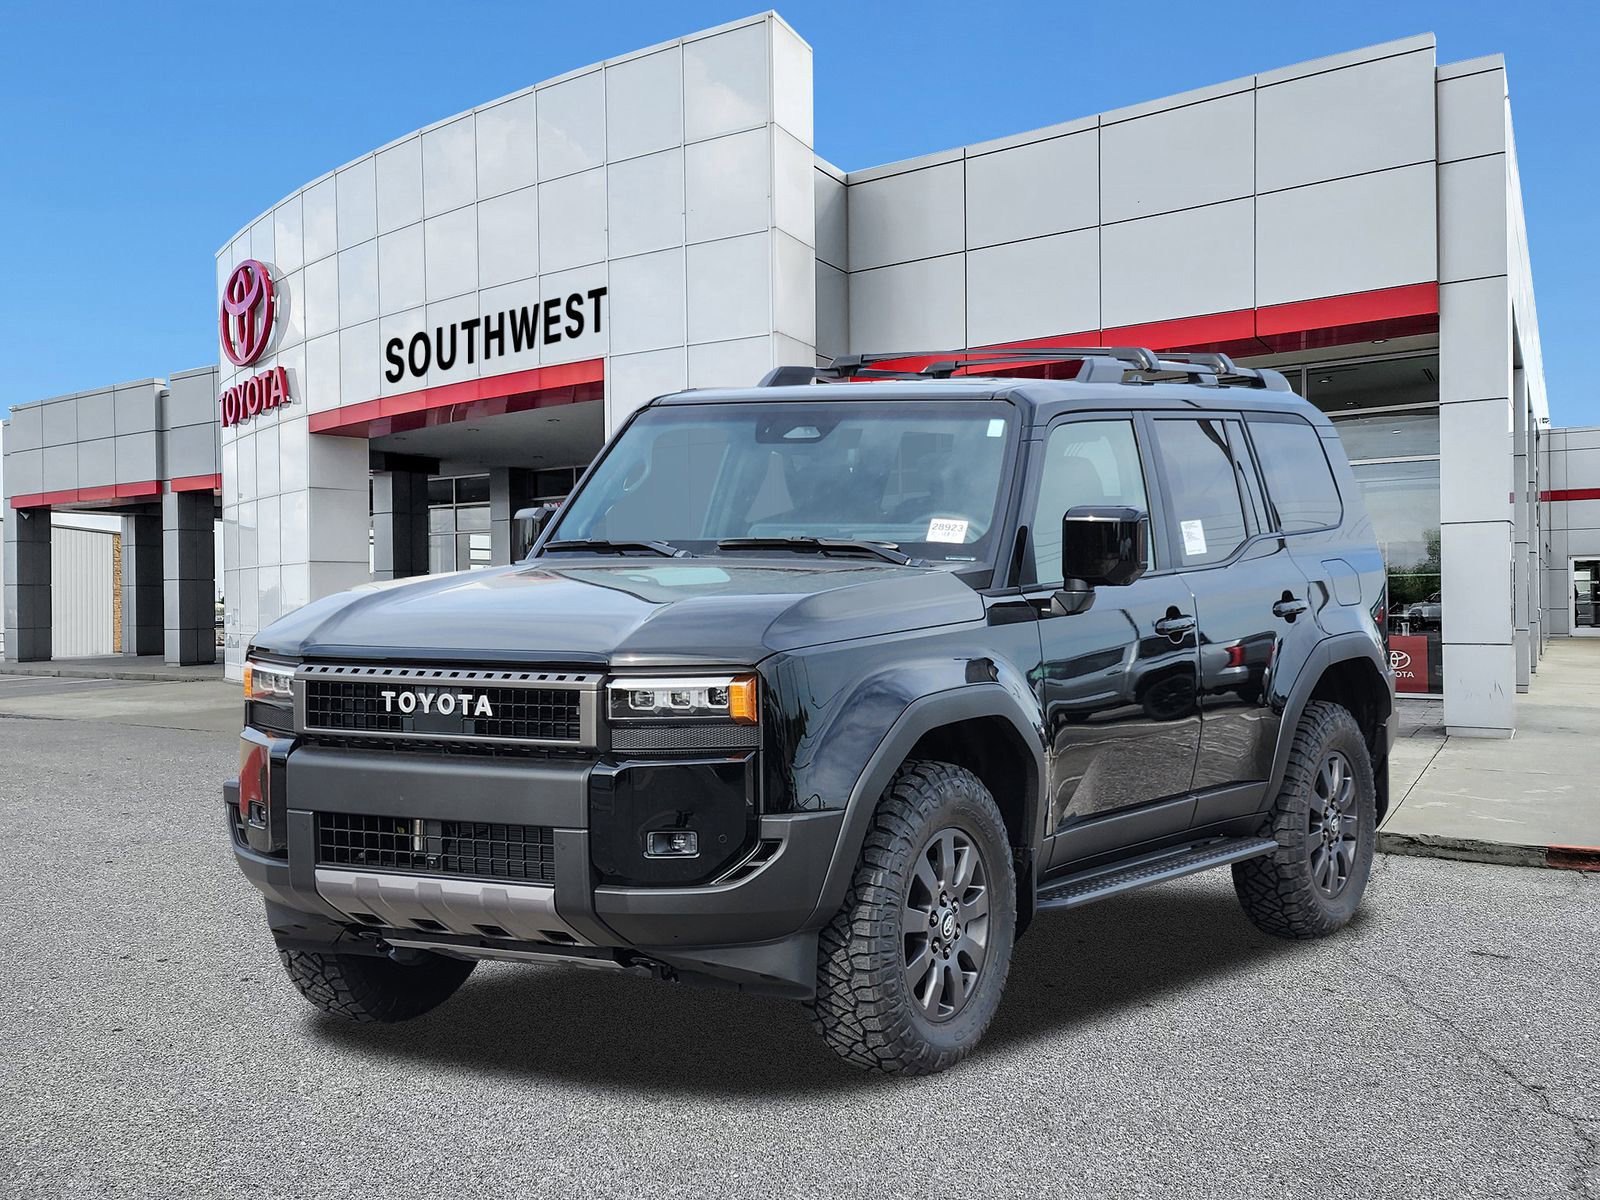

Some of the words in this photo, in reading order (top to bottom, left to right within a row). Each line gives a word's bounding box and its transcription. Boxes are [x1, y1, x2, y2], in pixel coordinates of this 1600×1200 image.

[385, 286, 608, 383] SOUTHWEST
[218, 365, 290, 428] TOYOTA
[932, 522, 964, 532] 28923
[1395, 670, 1415, 678] OTA
[381, 691, 493, 716] TOYOTA
